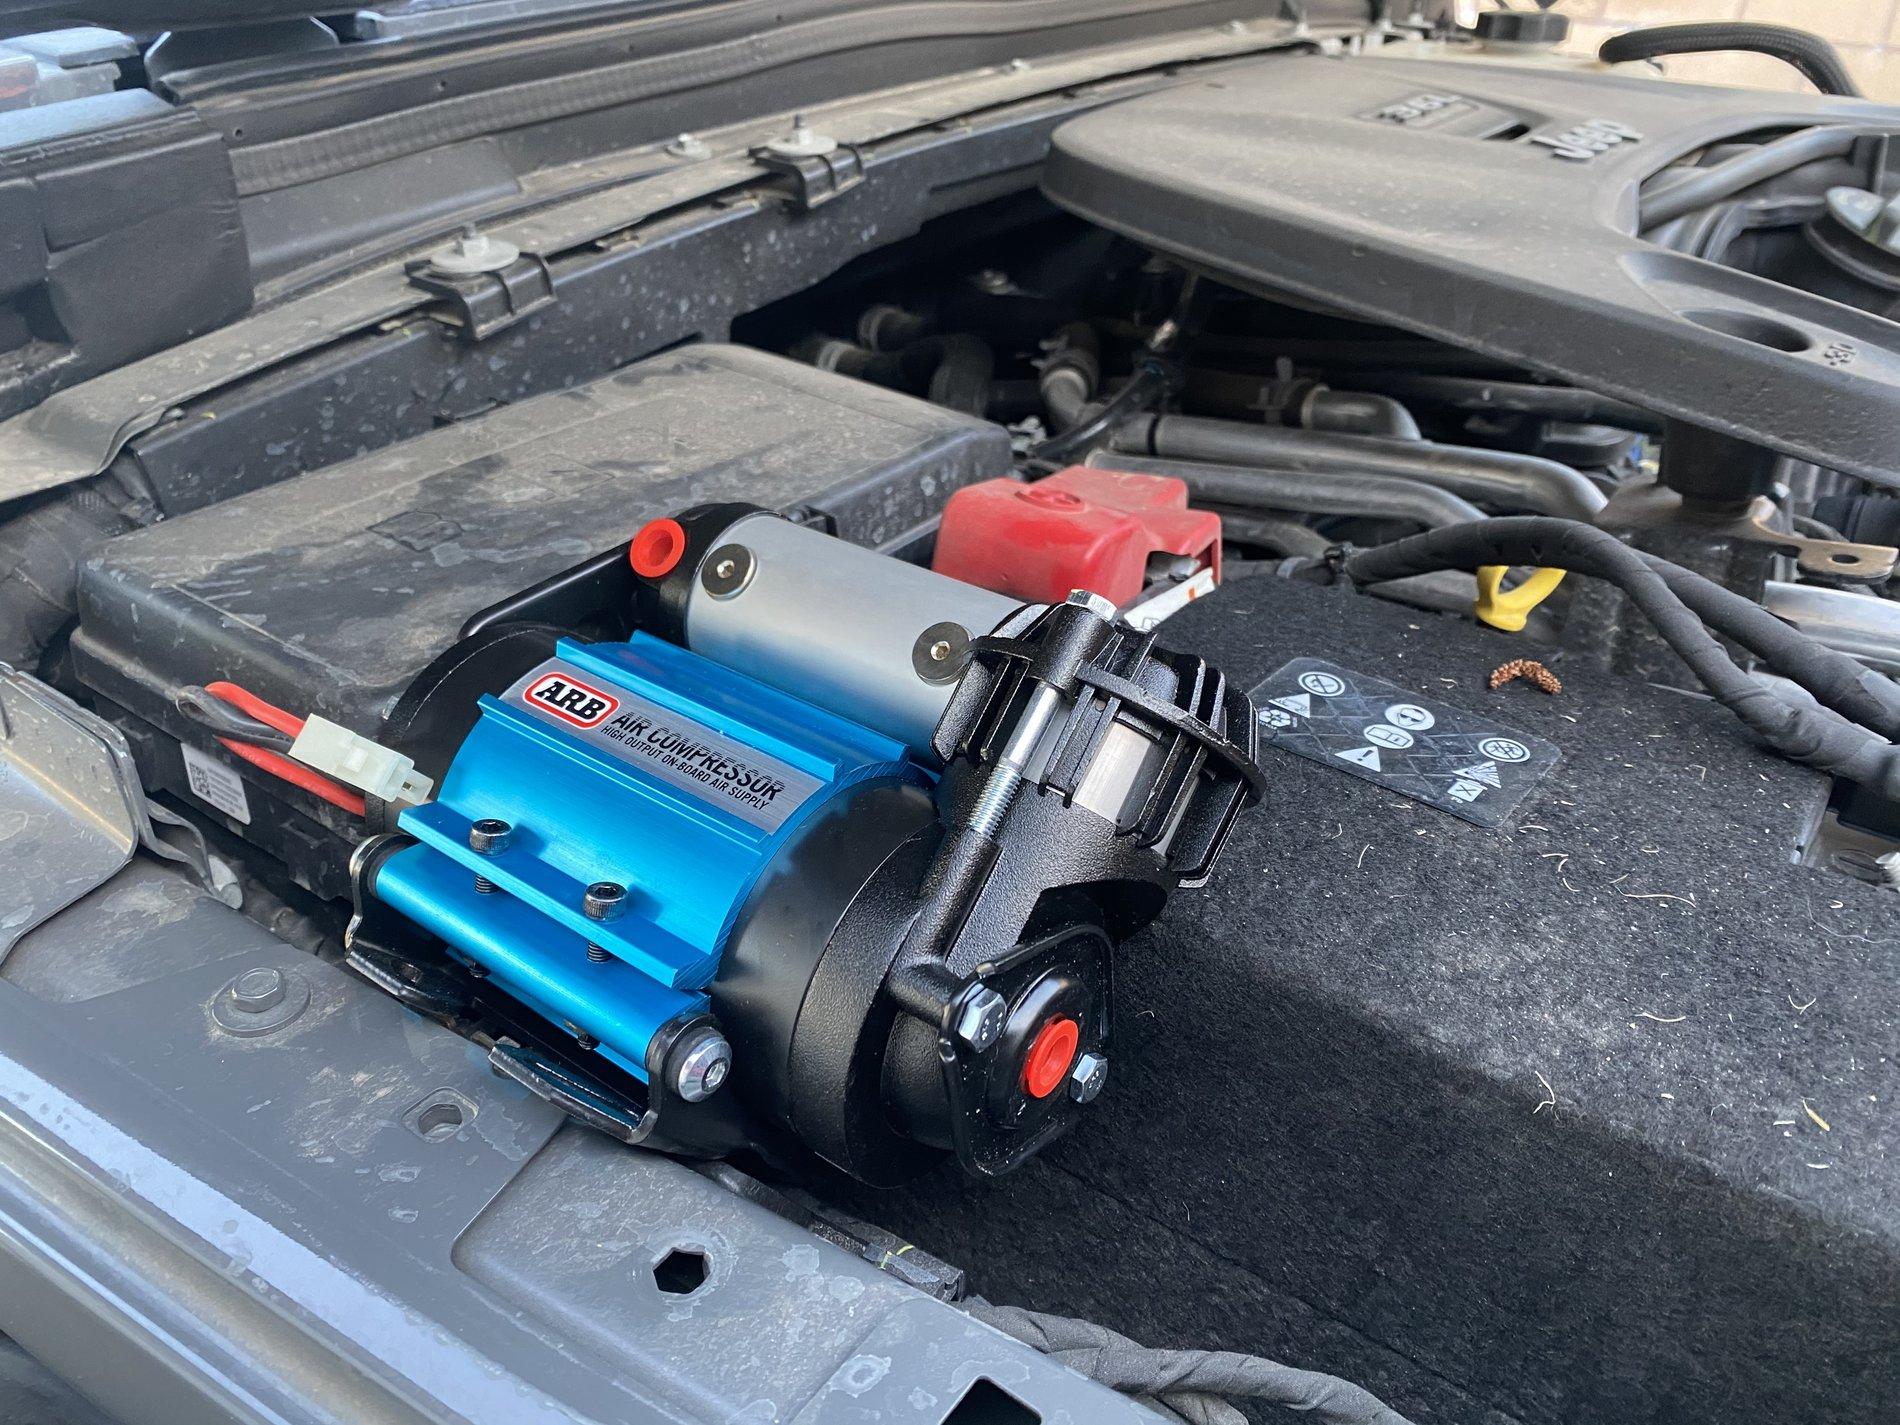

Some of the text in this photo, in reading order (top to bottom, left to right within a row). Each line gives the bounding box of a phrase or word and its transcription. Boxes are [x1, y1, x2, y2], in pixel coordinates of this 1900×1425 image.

[534, 680, 607, 721] ARB
[600, 725, 770, 811] HIGH OUTPUT ON-BOARD AIR SUPPLY
[610, 711, 786, 801] AIR COMPRESSOR
